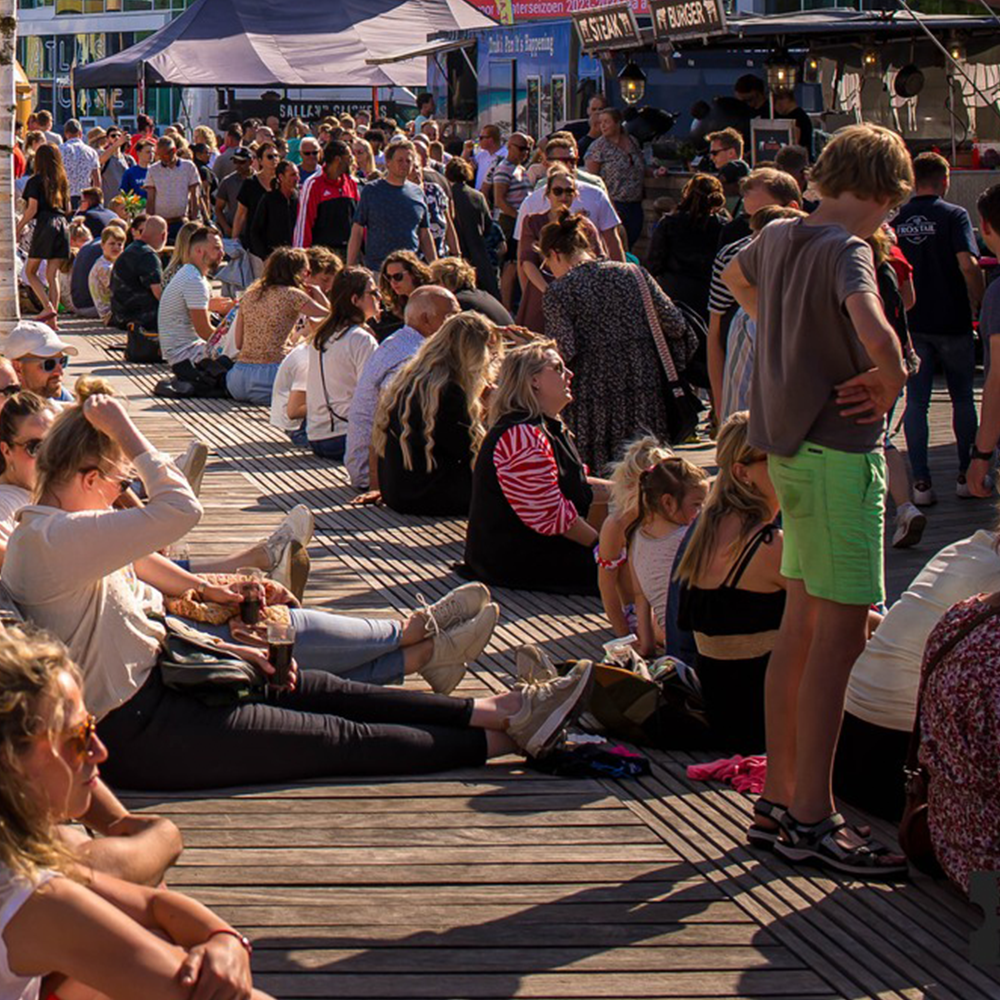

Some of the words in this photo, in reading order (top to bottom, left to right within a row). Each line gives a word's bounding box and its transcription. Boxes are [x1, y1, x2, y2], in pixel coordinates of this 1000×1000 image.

[496, 0, 563, 15] taterseizoen
[667, 0, 706, 29] BURGER
[588, 12, 623, 42] STEAK
